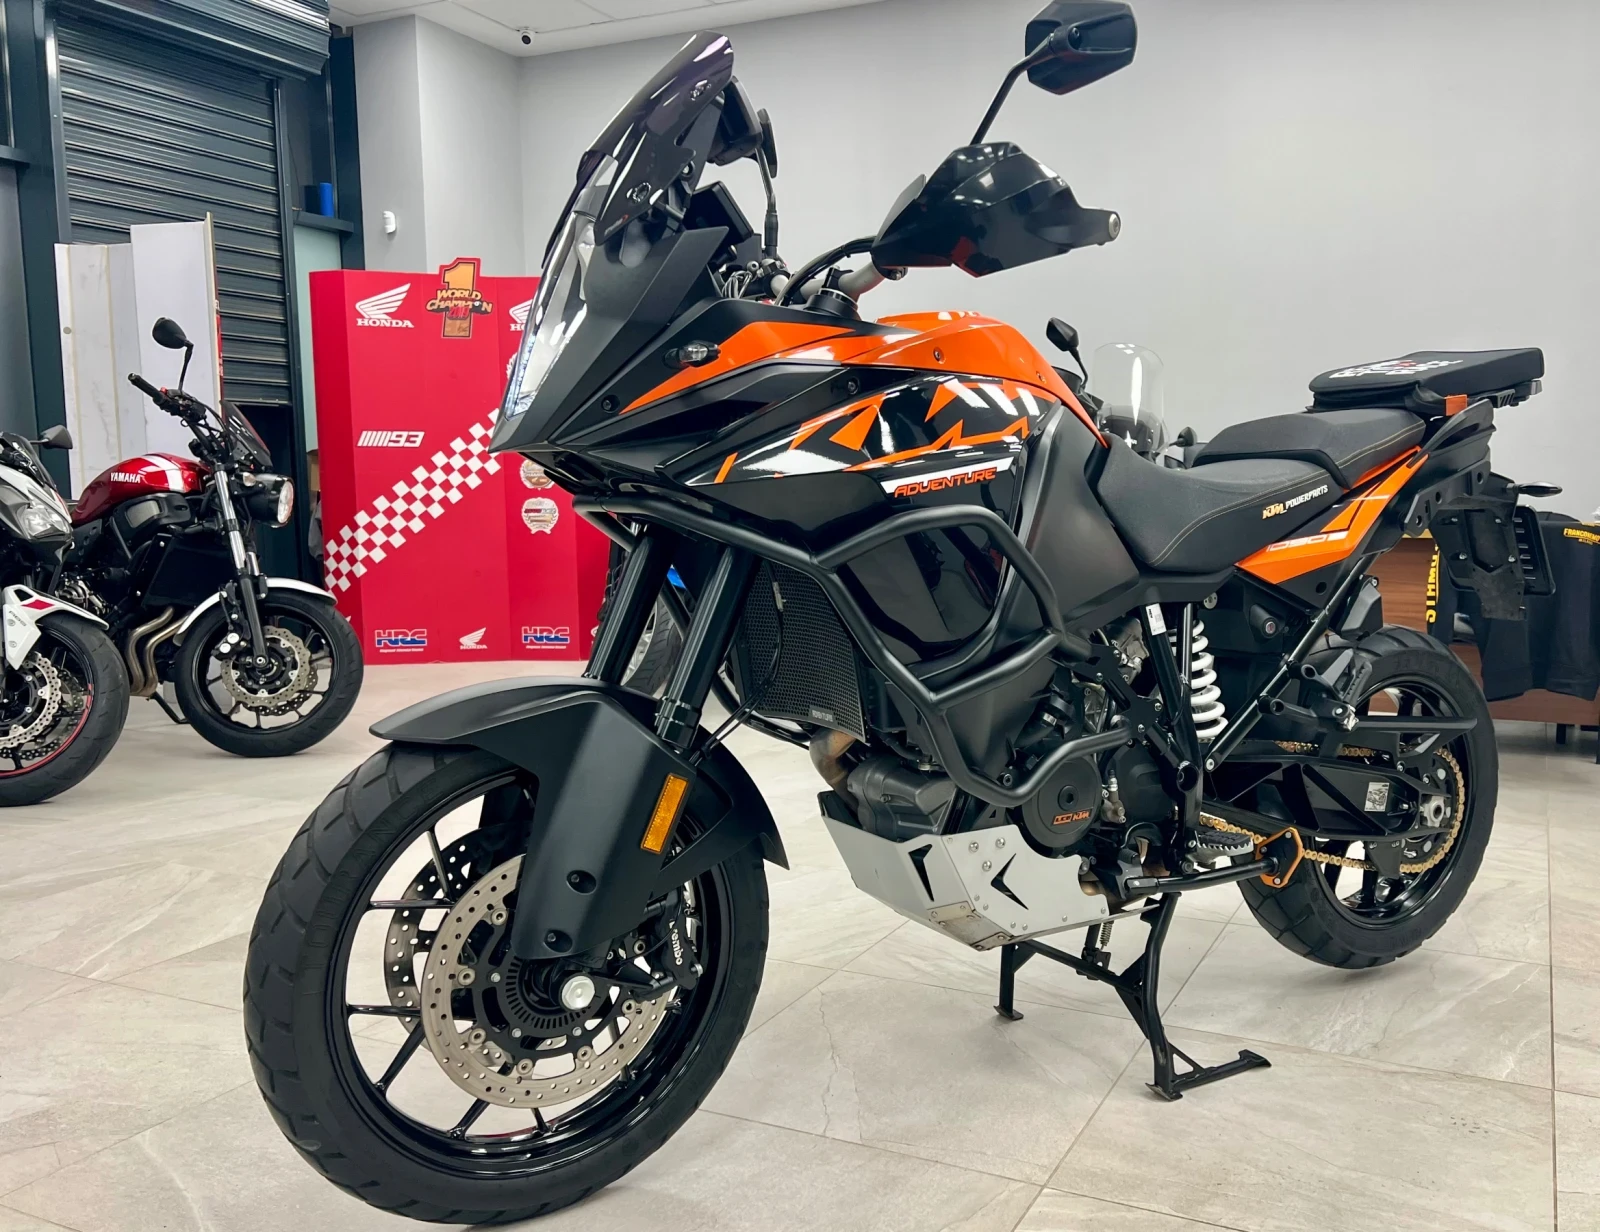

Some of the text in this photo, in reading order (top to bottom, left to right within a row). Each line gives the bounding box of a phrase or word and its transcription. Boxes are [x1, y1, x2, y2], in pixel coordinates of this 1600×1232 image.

[436, 289, 482, 300] WORLD
[356, 318, 415, 328] HONDA
[110, 472, 141, 484] YAMAHA
[894, 466, 998, 498] ADVENTURE
[1262, 485, 1329, 519] KTM POWERPARTS
[374, 628, 428, 648] HRC
[522, 626, 571, 644] HRC
